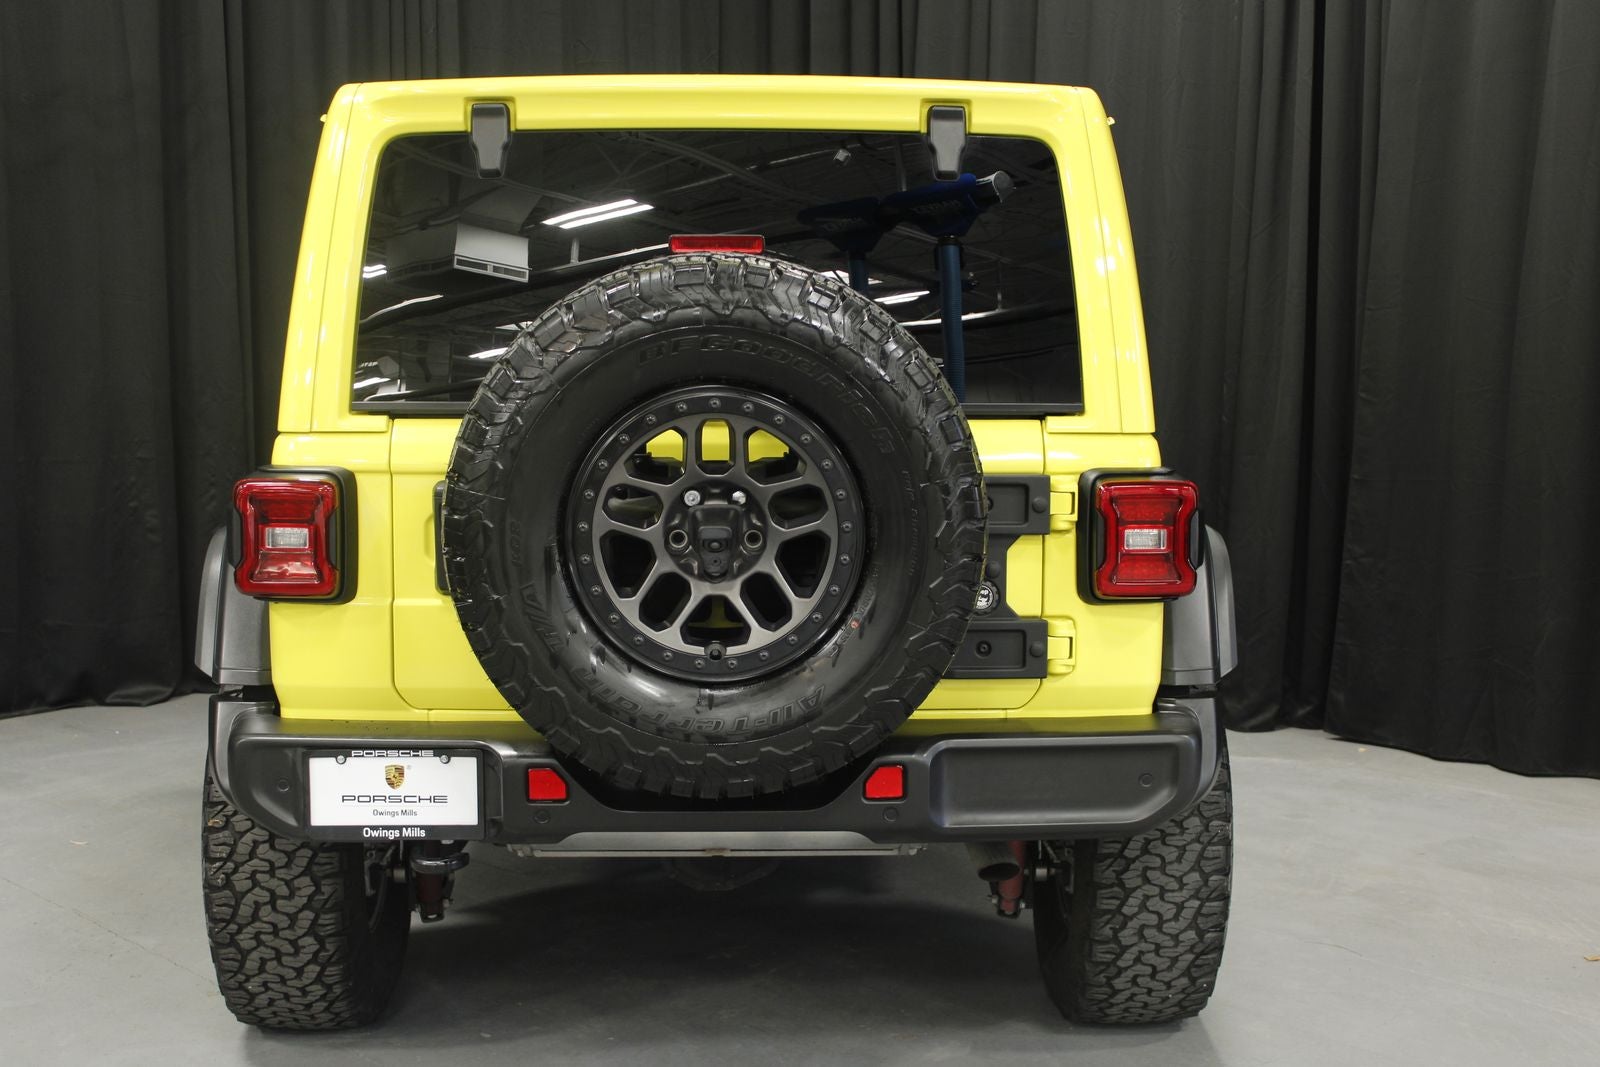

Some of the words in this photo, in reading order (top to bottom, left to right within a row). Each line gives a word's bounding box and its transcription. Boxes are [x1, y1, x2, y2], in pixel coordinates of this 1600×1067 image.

[341, 795, 448, 804] PORSCHE
[372, 809, 400, 818] Owings
[400, 809, 418, 817] Mills
[362, 827, 400, 840] Owings
[402, 827, 426, 839] Mills
